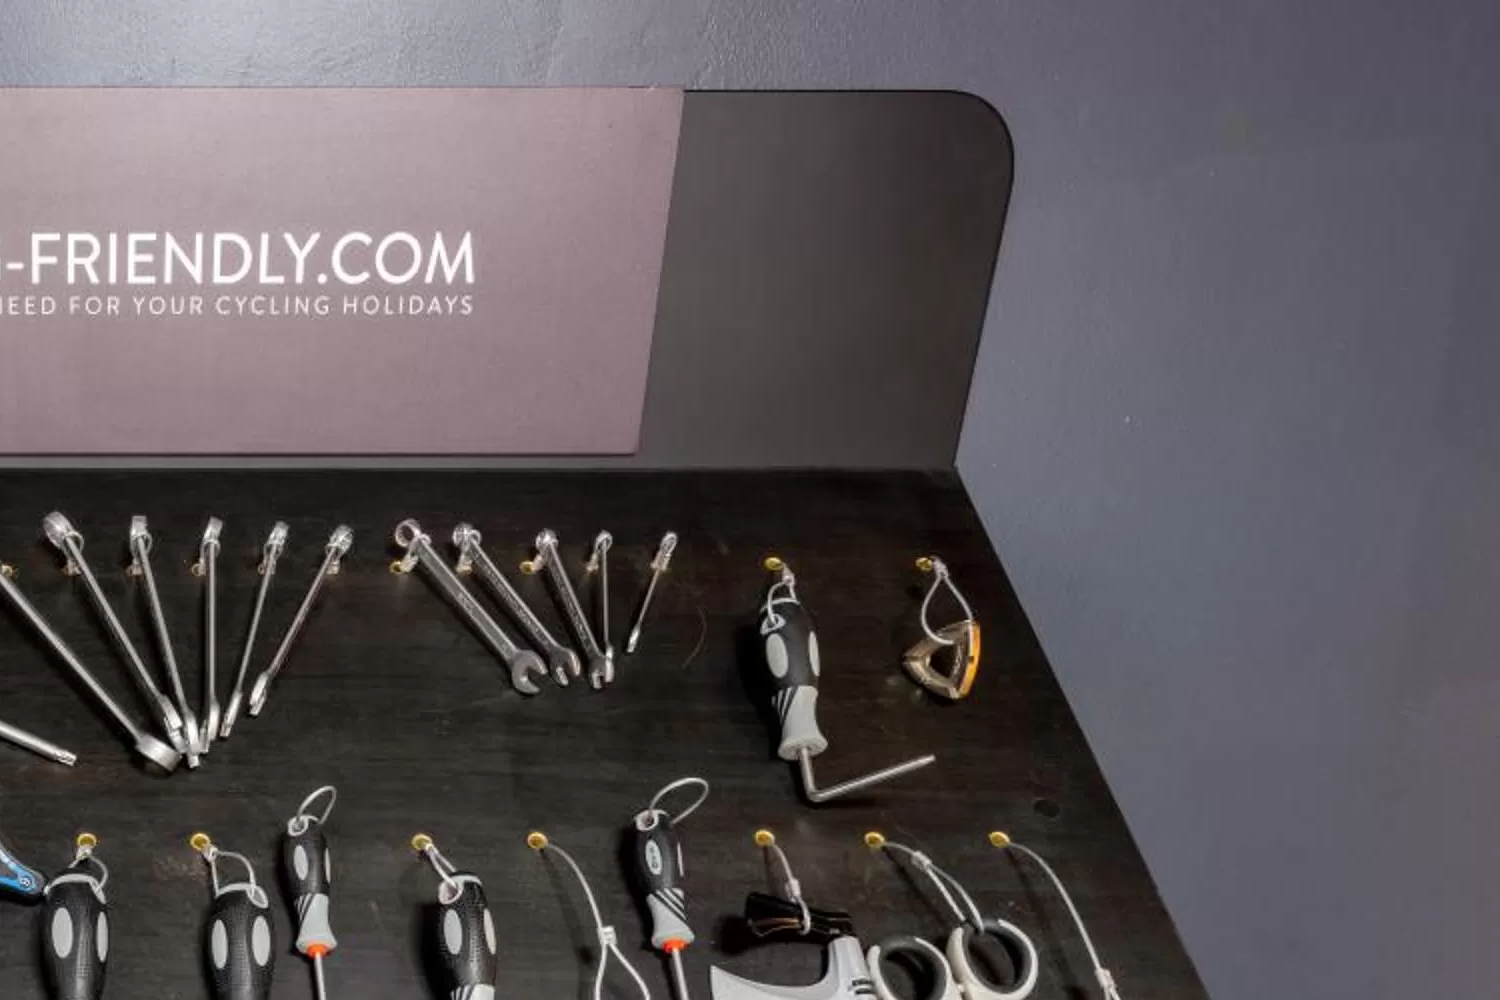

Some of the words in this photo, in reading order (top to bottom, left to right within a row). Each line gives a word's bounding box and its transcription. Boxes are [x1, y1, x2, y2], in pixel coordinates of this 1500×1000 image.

[69, 295, 120, 316] FOR
[132, 295, 203, 316] YOUR
[214, 295, 329, 316] CYCLING
[343, 295, 473, 316] HOLIDAYS
